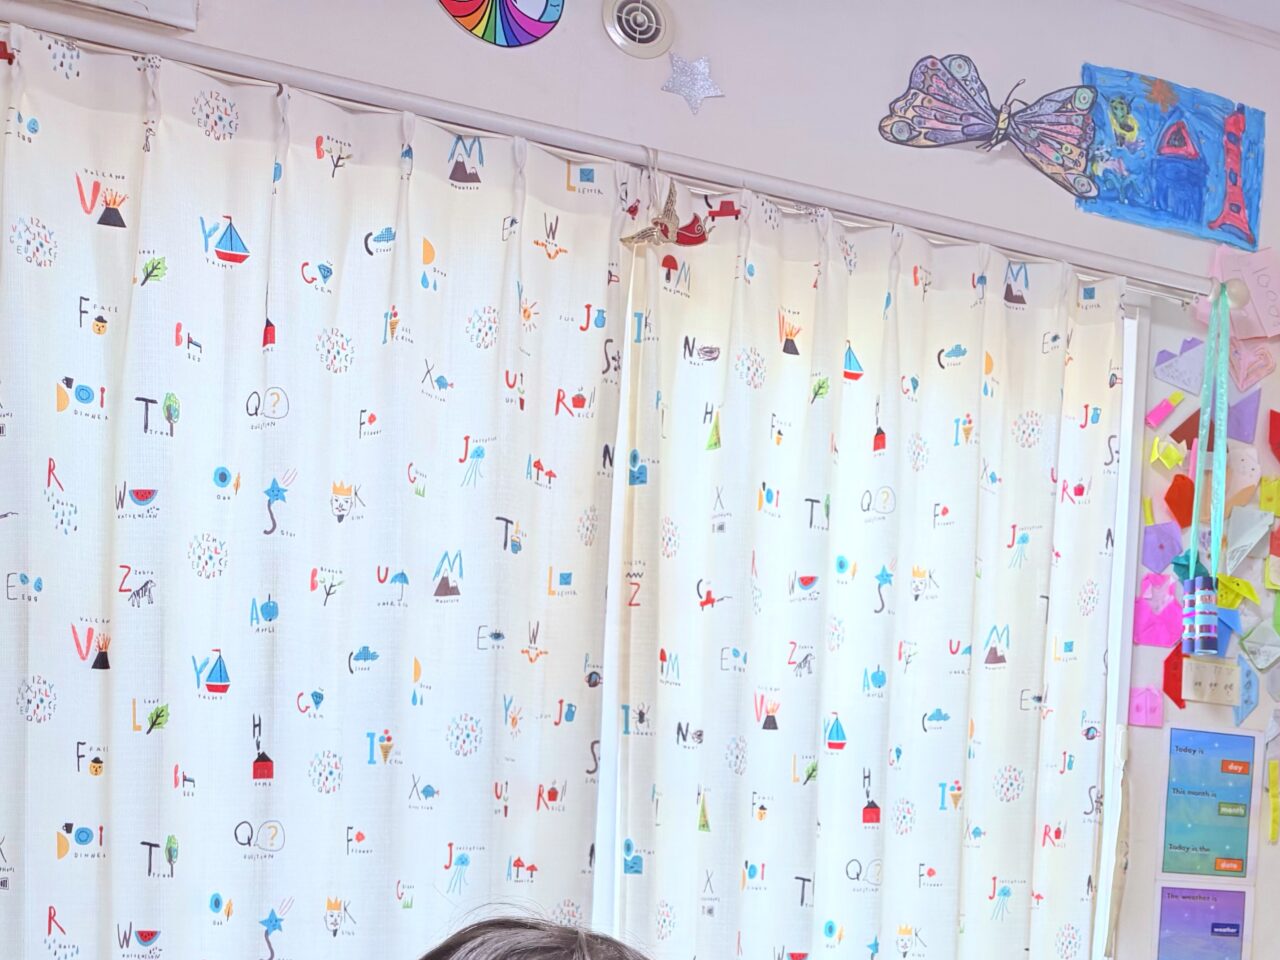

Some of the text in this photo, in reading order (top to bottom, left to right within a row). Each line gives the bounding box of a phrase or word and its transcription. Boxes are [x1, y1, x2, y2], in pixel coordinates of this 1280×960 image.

[448, 135, 484, 167] M
[75, 171, 101, 215] V
[199, 216, 220, 253] Y
[544, 212, 559, 240] W
[79, 296, 90, 328] F
[579, 304, 592, 332] J
[683, 335, 696, 359] N
[505, 370, 517, 389] U
[135, 396, 158, 434] T
[246, 391, 261, 417] Q
[555, 388, 574, 416] R
[703, 401, 714, 424] H
[359, 409, 368, 439] F
[458, 435, 471, 464] J
[47, 457, 65, 491] R
[115, 481, 127, 510] W
[353, 484, 367, 508] K
[495, 515, 514, 550] T
[118, 564, 133, 593] Z
[377, 565, 389, 584] U
[432, 549, 464, 582] M
[6, 572, 18, 601] E
[249, 597, 259, 627] A
[71, 623, 95, 661] V
[477, 624, 489, 651] E
[949, 639, 960, 655] U
[984, 623, 1010, 651] M
[787, 641, 798, 665] Z
[192, 654, 210, 689] Y
[132, 698, 142, 732] L
[252, 713, 262, 740] H
[676, 721, 690, 745] N
[76, 741, 87, 773] F
[1175, 745, 1197, 755] Today
[1229, 763, 1243, 772] day
[1220, 805, 1245, 815] month
[234, 820, 253, 847] Q
[140, 841, 161, 878] T
[443, 842, 454, 870] J
[845, 859, 862, 881] Q
[1220, 861, 1238, 869] date
[794, 875, 812, 907] T
[47, 905, 67, 937] R
[117, 921, 132, 949] W
